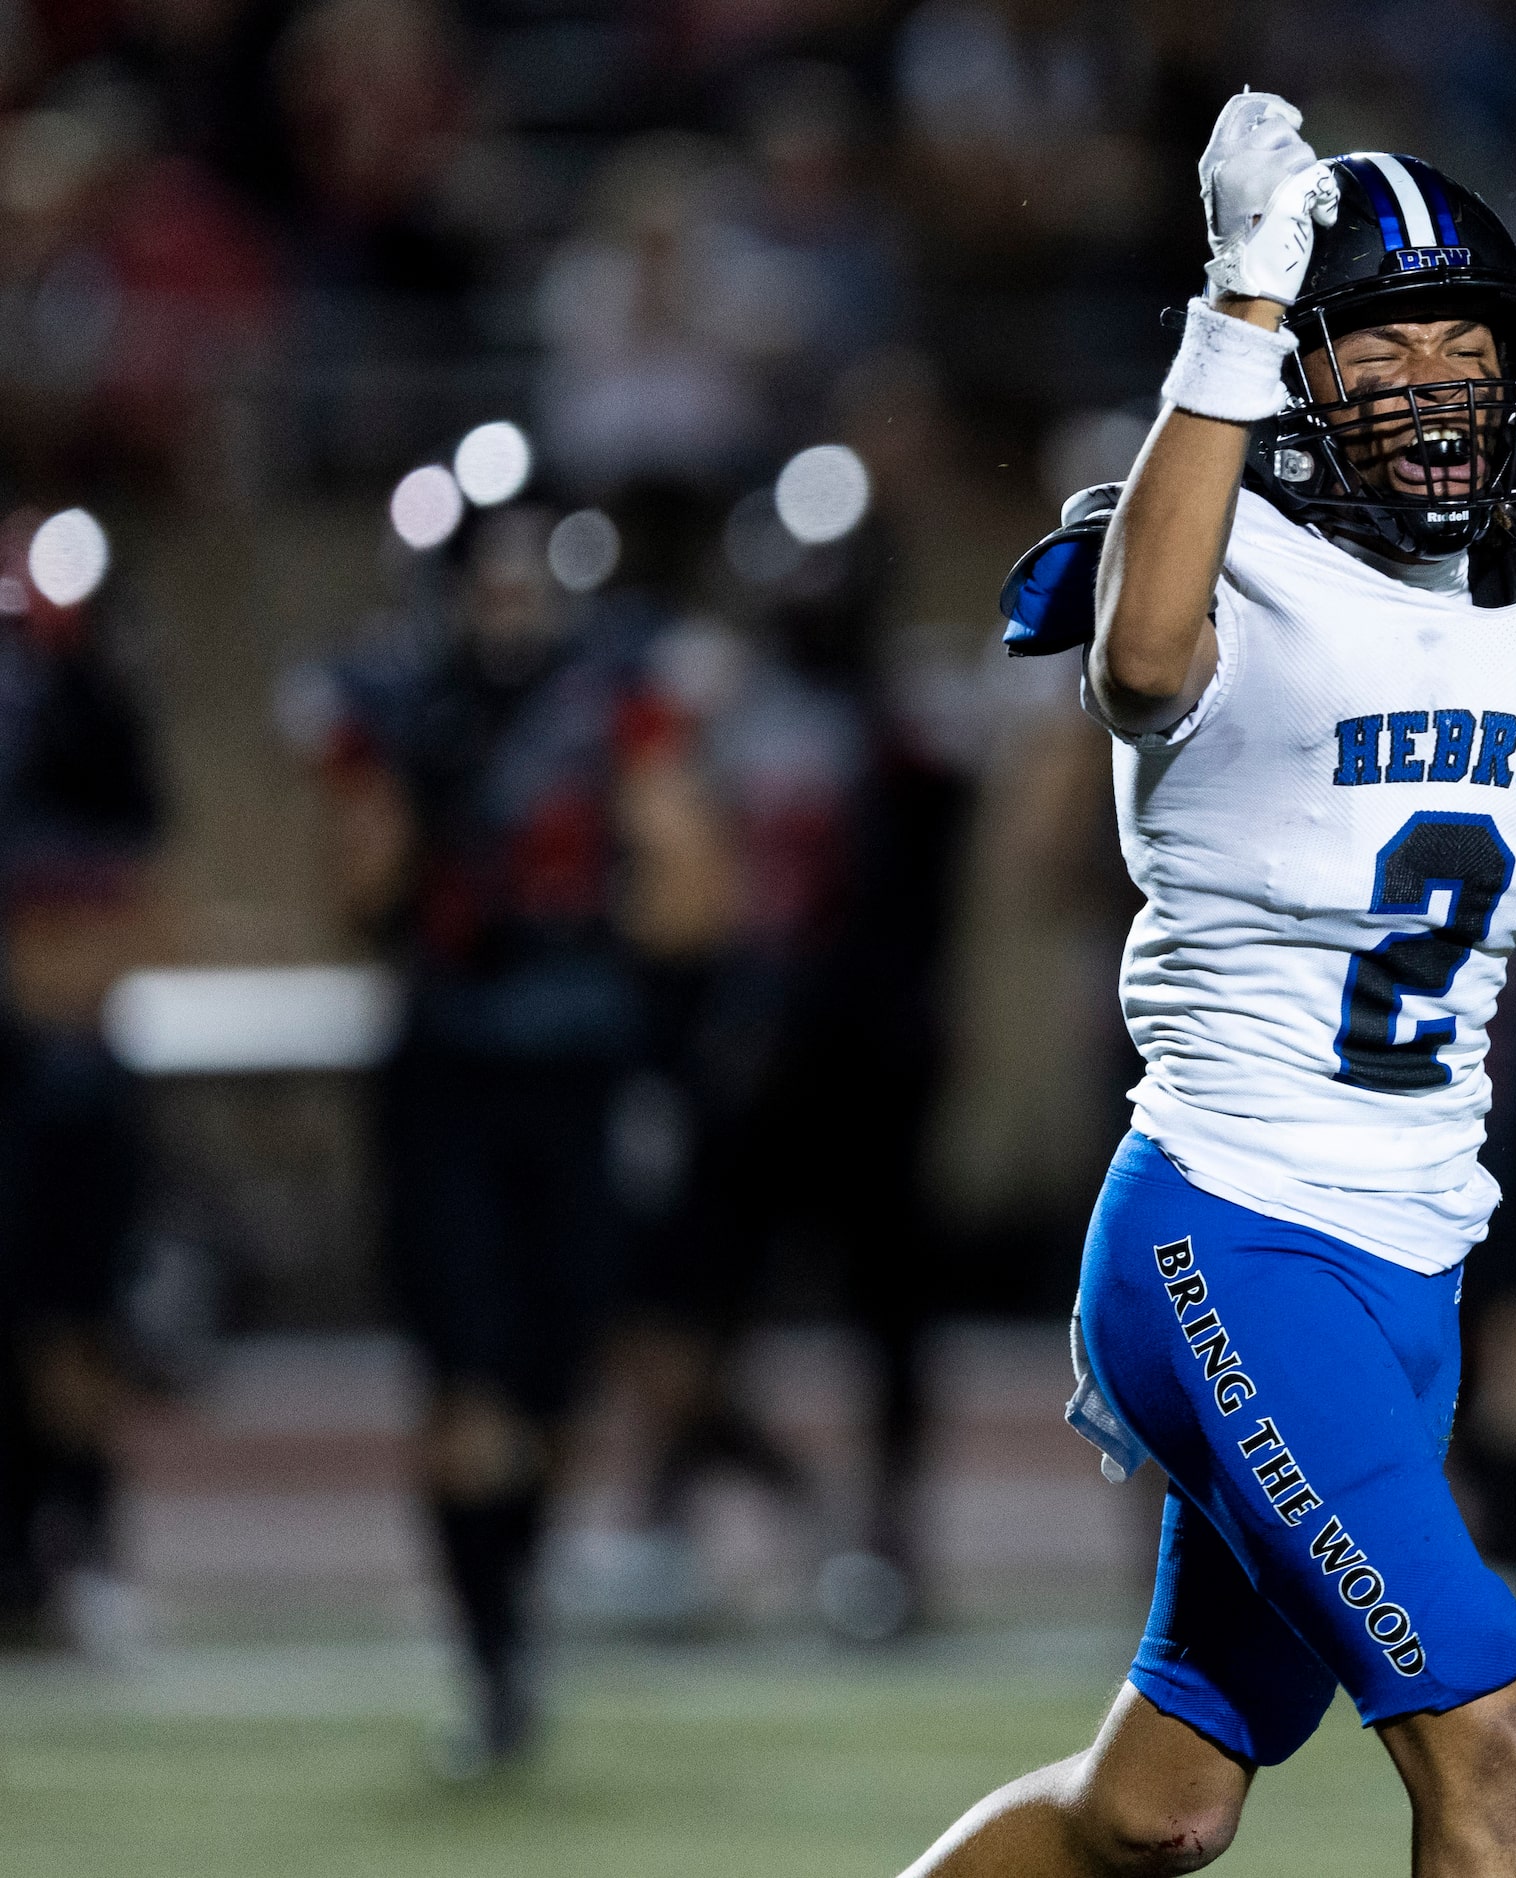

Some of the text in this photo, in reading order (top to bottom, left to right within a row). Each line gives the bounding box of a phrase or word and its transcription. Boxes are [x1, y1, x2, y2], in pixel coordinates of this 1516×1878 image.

[1427, 510, 1470, 522] Riddell
[1331, 810, 1516, 1090] 2
[1153, 1235, 1427, 1678] BRING THE WOOD
